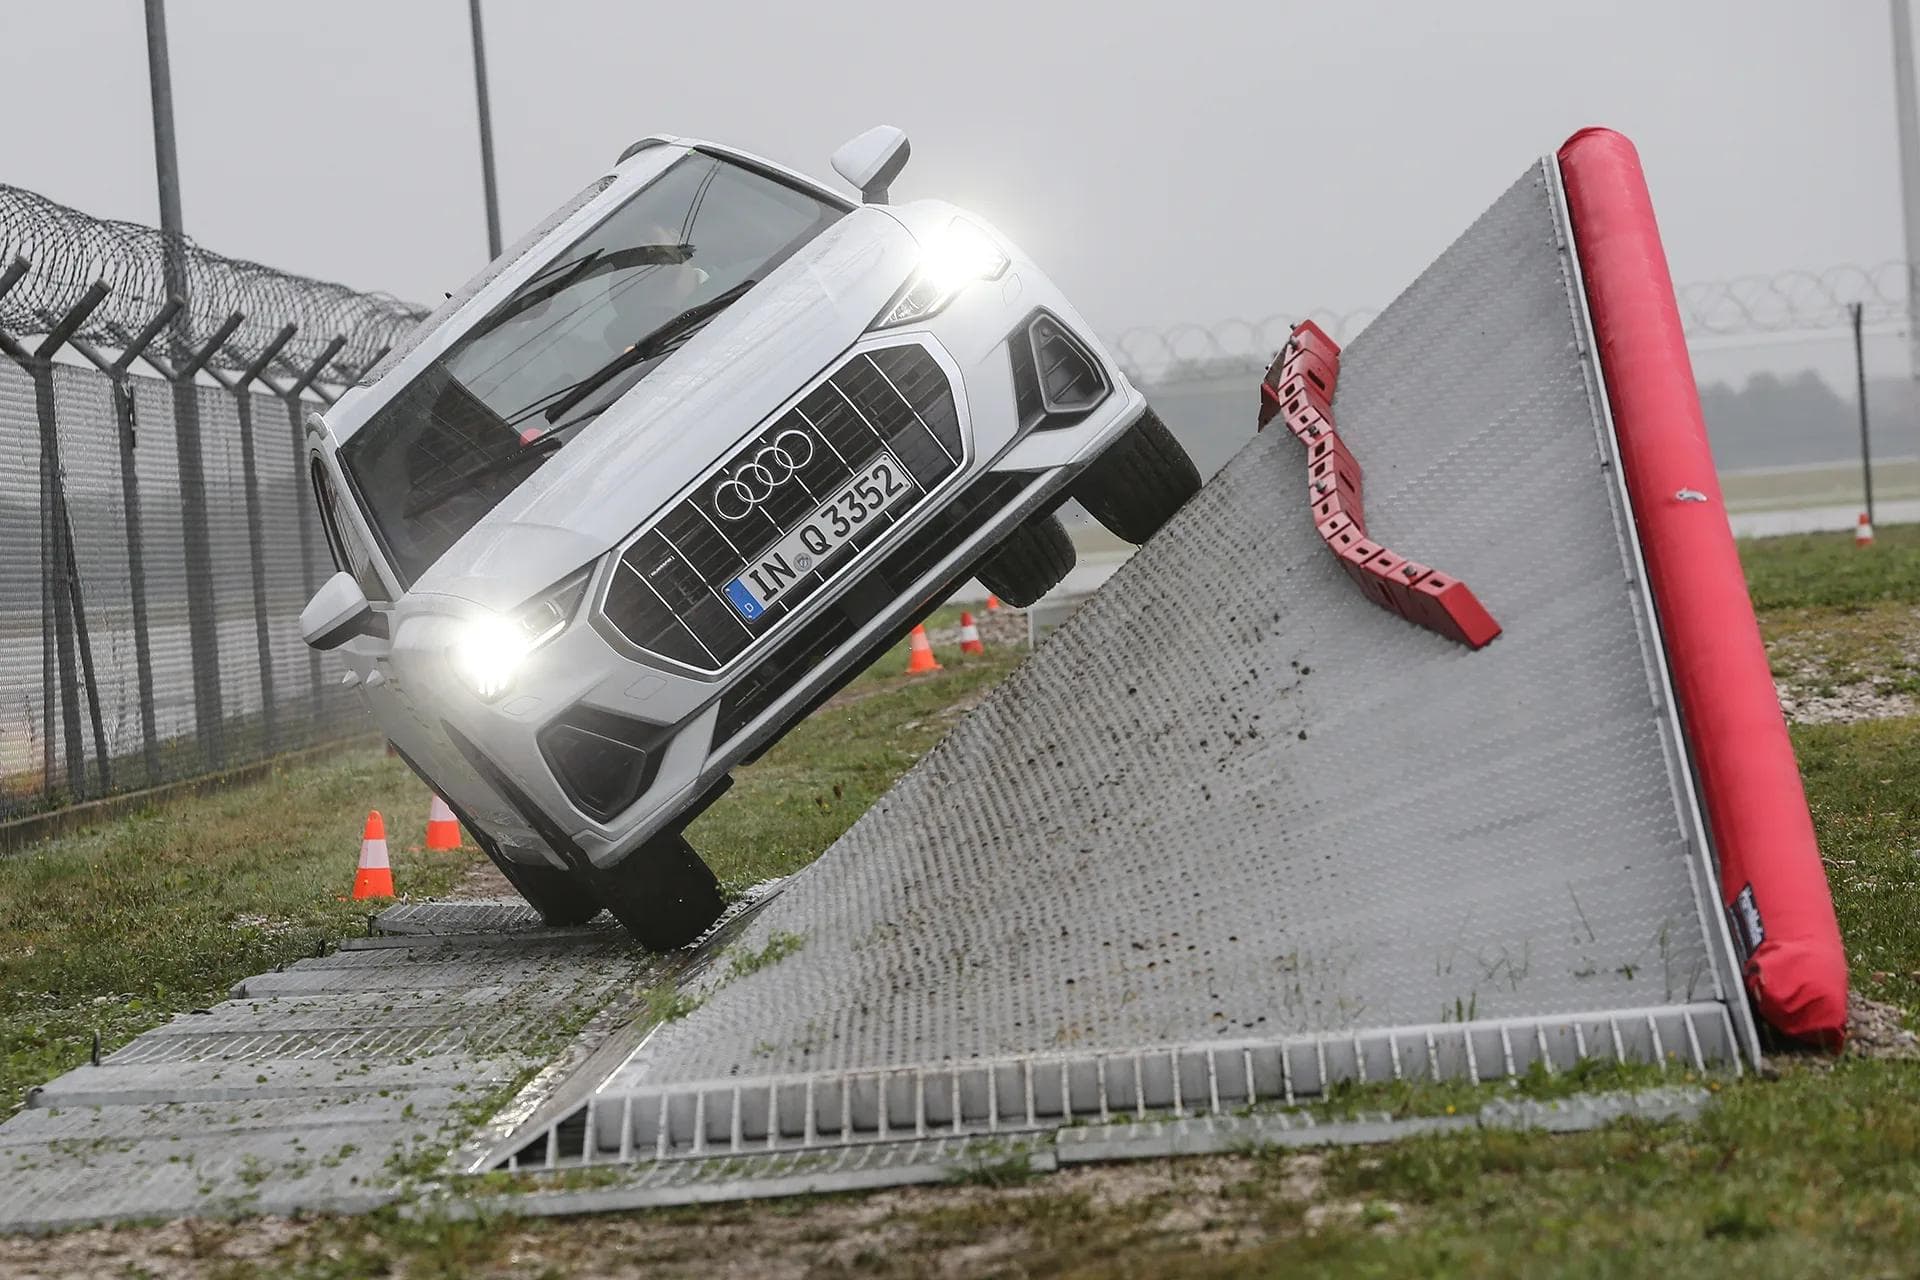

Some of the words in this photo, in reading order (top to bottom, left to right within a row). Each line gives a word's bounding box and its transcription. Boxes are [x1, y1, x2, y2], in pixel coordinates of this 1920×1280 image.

[749, 553, 797, 602] IN
[800, 525, 832, 555] Q
[821, 464, 904, 538] 3352
[744, 603, 754, 613] D
